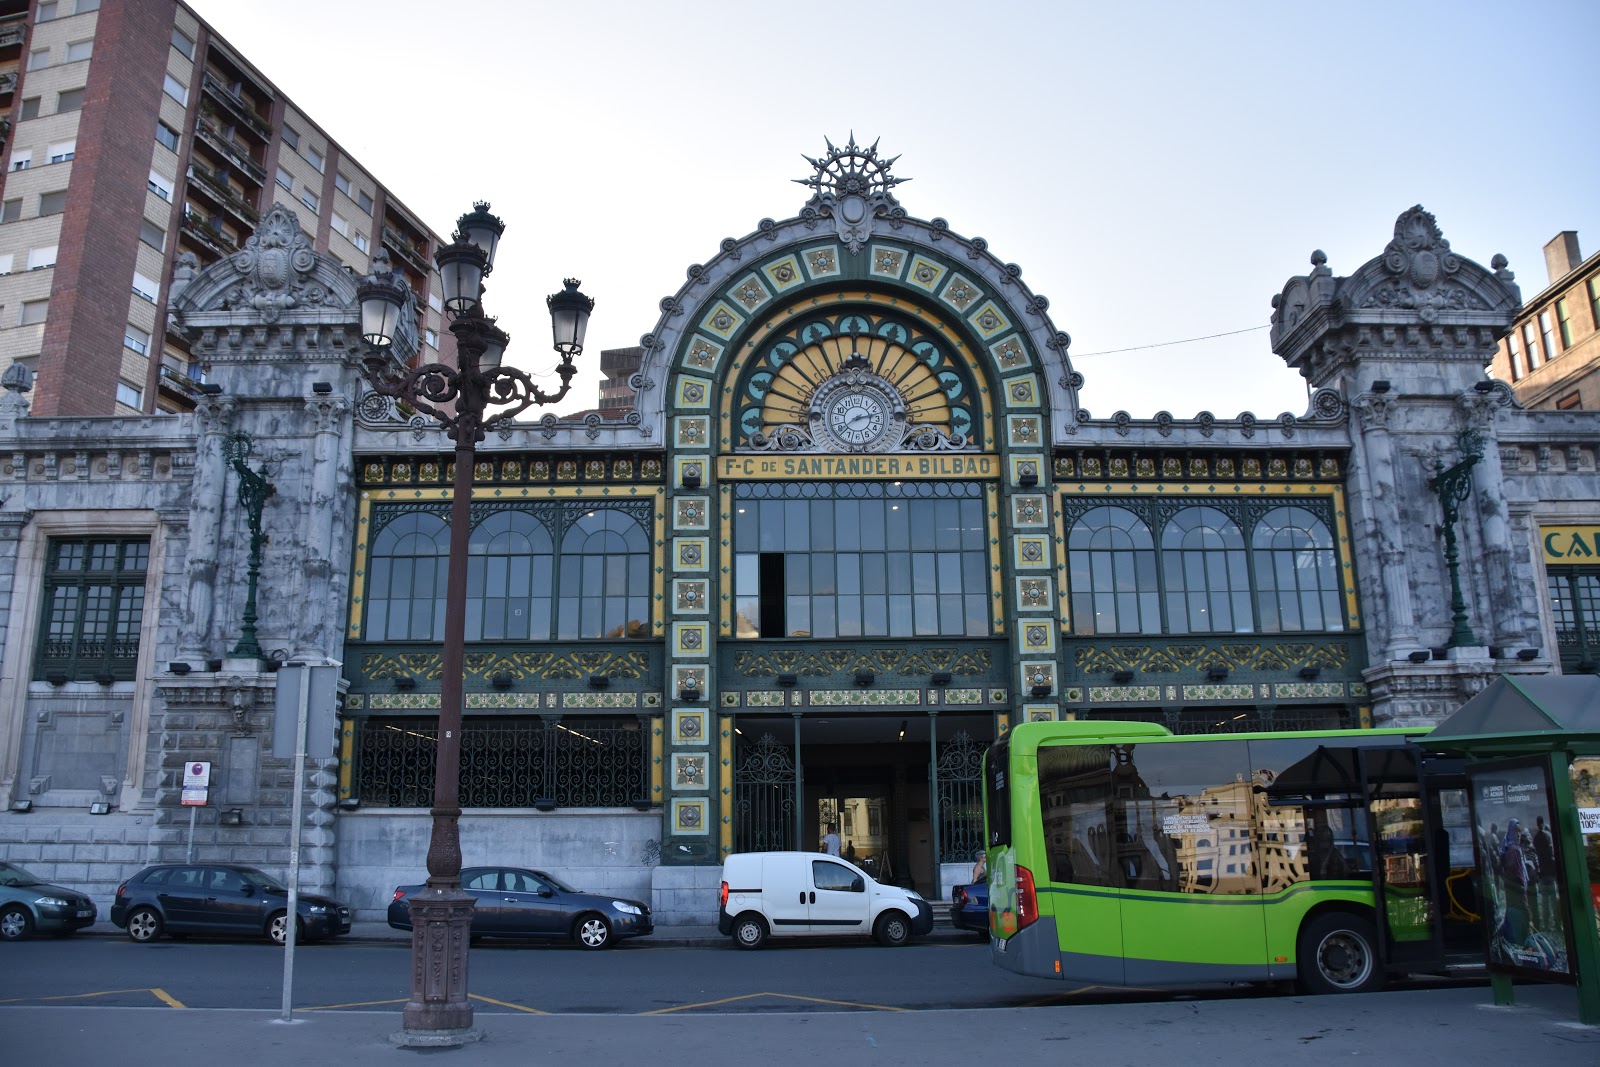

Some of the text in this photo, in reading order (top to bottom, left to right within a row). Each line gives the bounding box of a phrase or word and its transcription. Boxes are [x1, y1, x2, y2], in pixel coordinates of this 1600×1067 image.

[761, 460, 777, 472] DE
[784, 458, 900, 475] SANTANDER
[905, 460, 914, 472] A
[918, 457, 991, 474] BILBAO
[1544, 532, 1600, 558] CA
[1507, 784, 1538, 793] Cambiamos
[1508, 794, 1530, 802] historias
